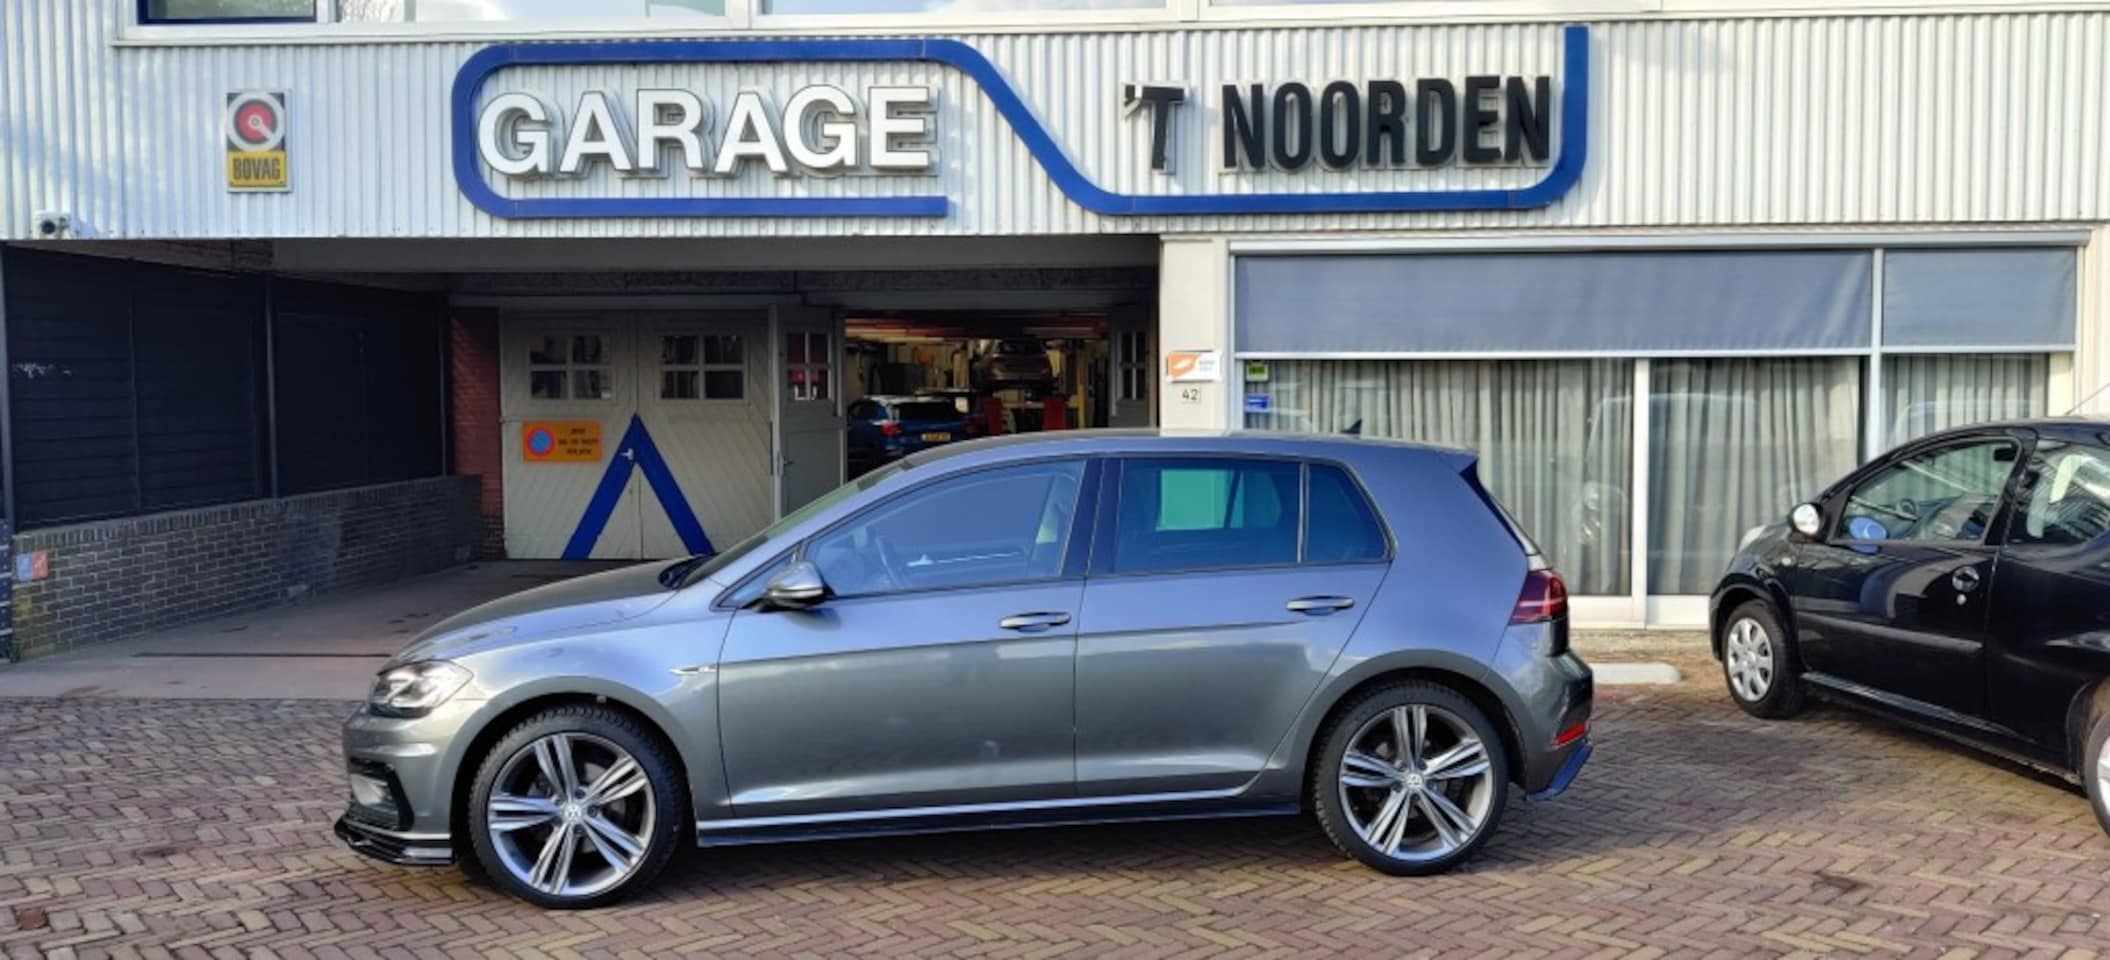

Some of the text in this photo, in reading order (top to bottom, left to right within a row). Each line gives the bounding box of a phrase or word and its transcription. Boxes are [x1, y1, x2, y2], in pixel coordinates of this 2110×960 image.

[478, 75, 1551, 176] GARAGE 'T NOORDEN
[232, 158, 281, 180] BOVAG
[1182, 388, 1199, 401] 42
